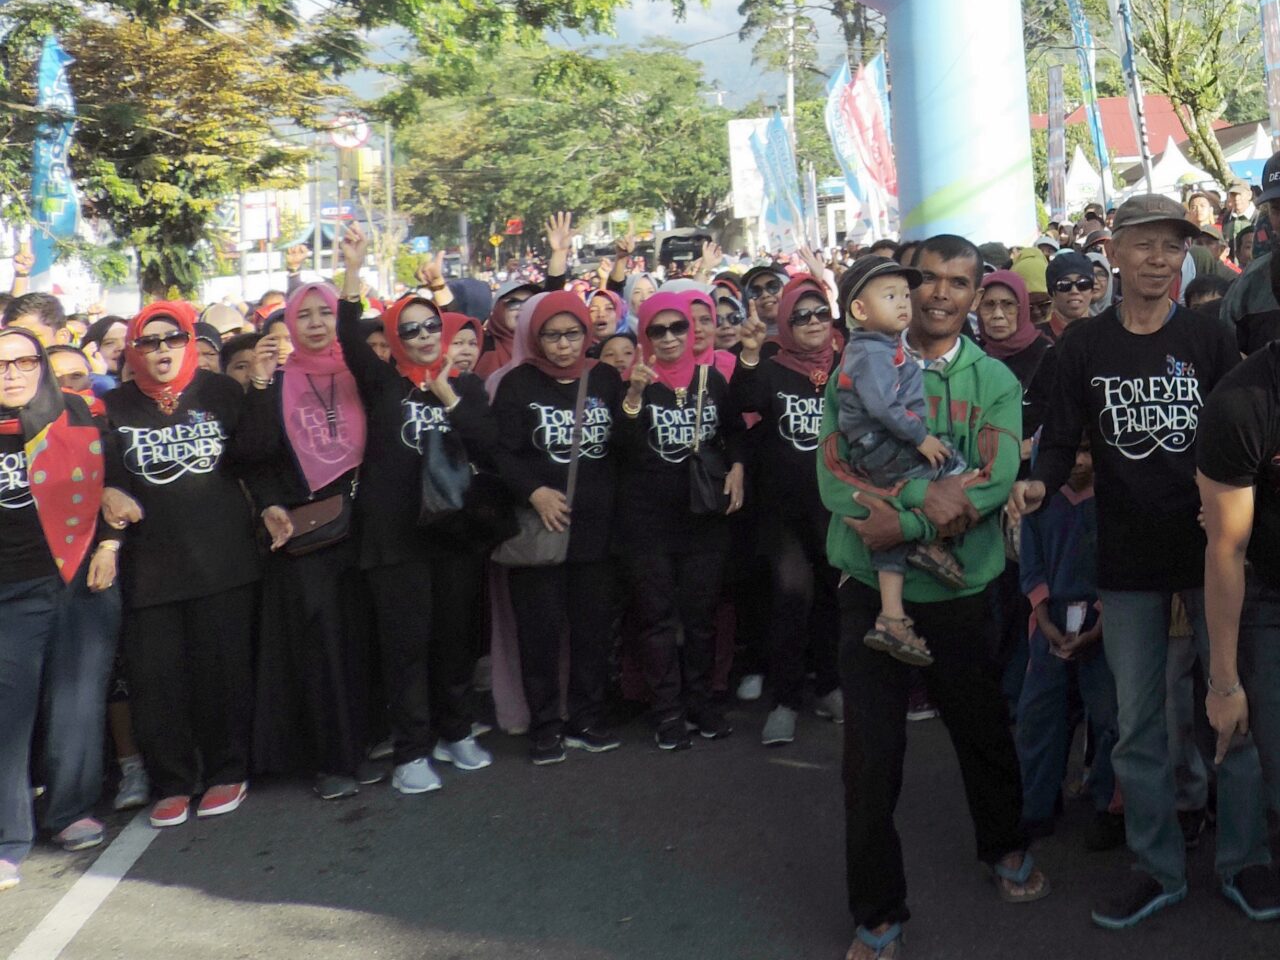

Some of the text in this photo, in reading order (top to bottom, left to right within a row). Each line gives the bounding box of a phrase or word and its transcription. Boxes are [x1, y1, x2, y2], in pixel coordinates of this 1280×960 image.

[1091, 376, 1204, 407] FOREVER
[118, 420, 228, 448] FOREVER
[1103, 404, 1199, 441] FRIENDS
[133, 437, 224, 469] FRIENDS
